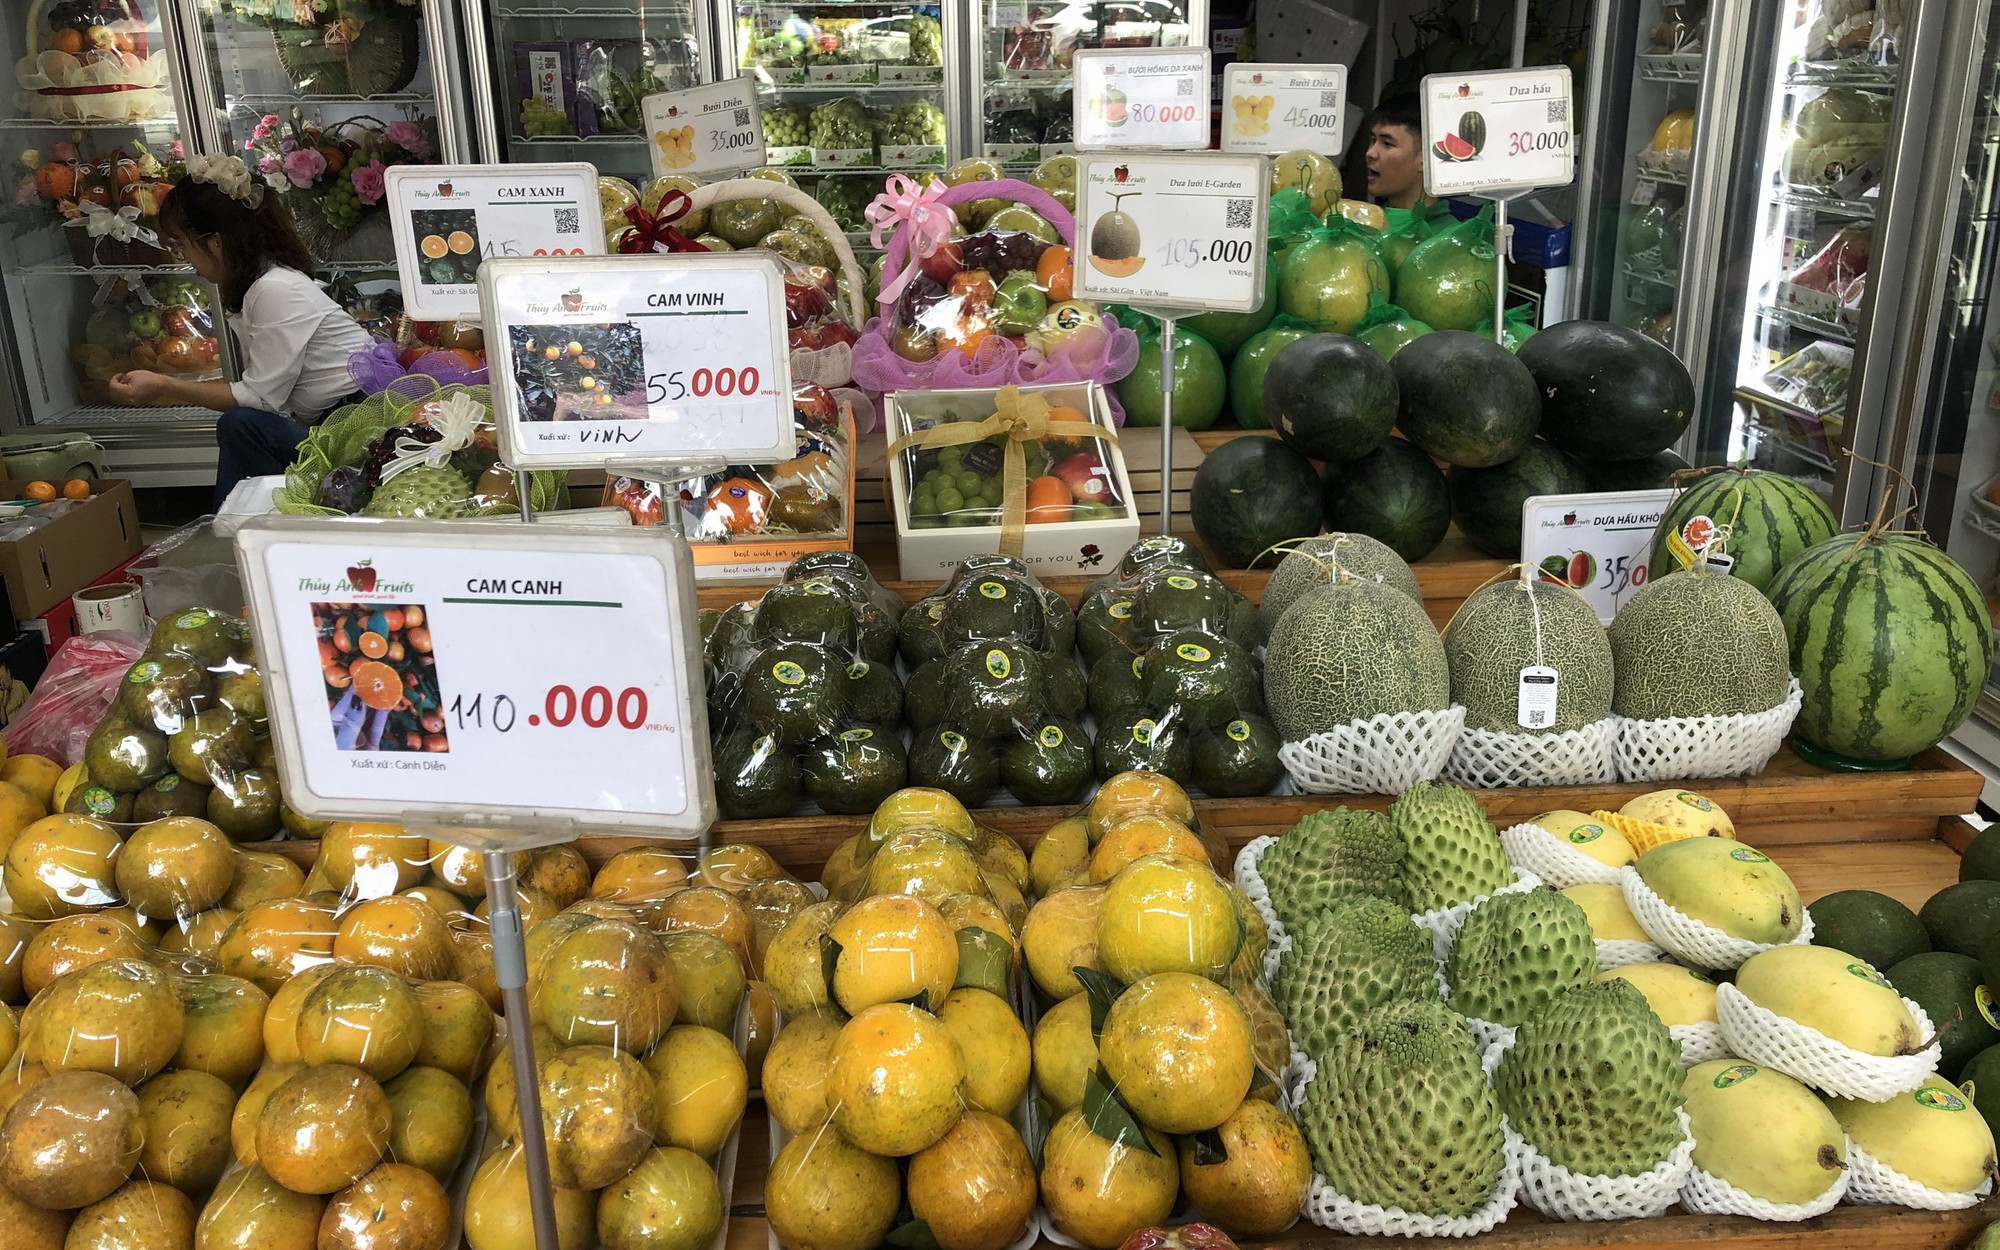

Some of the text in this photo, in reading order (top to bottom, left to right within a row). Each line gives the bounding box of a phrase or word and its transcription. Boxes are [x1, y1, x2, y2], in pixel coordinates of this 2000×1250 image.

[1182, 64, 1203, 72] XANH
[1509, 82, 1551, 96] Dưa hấu
[703, 102, 721, 113] Bưởi
[1170, 178, 1242, 189] Dưa lưới E-Garden
[497, 186, 565, 198] CAM XANH
[646, 292, 724, 308] CAM VINH
[1593, 515, 1616, 526] DƯA
[1617, 513, 1638, 525] HẤU
[1048, 554, 1074, 563] YOU
[298, 577, 331, 596] Thủy
[375, 578, 415, 593] Fruits
[466, 578, 563, 596] CAM CANH
[644, 722, 676, 735] VNĐ/kg
[350, 759, 374, 769] Xuất
[394, 760, 421, 770] Canh
